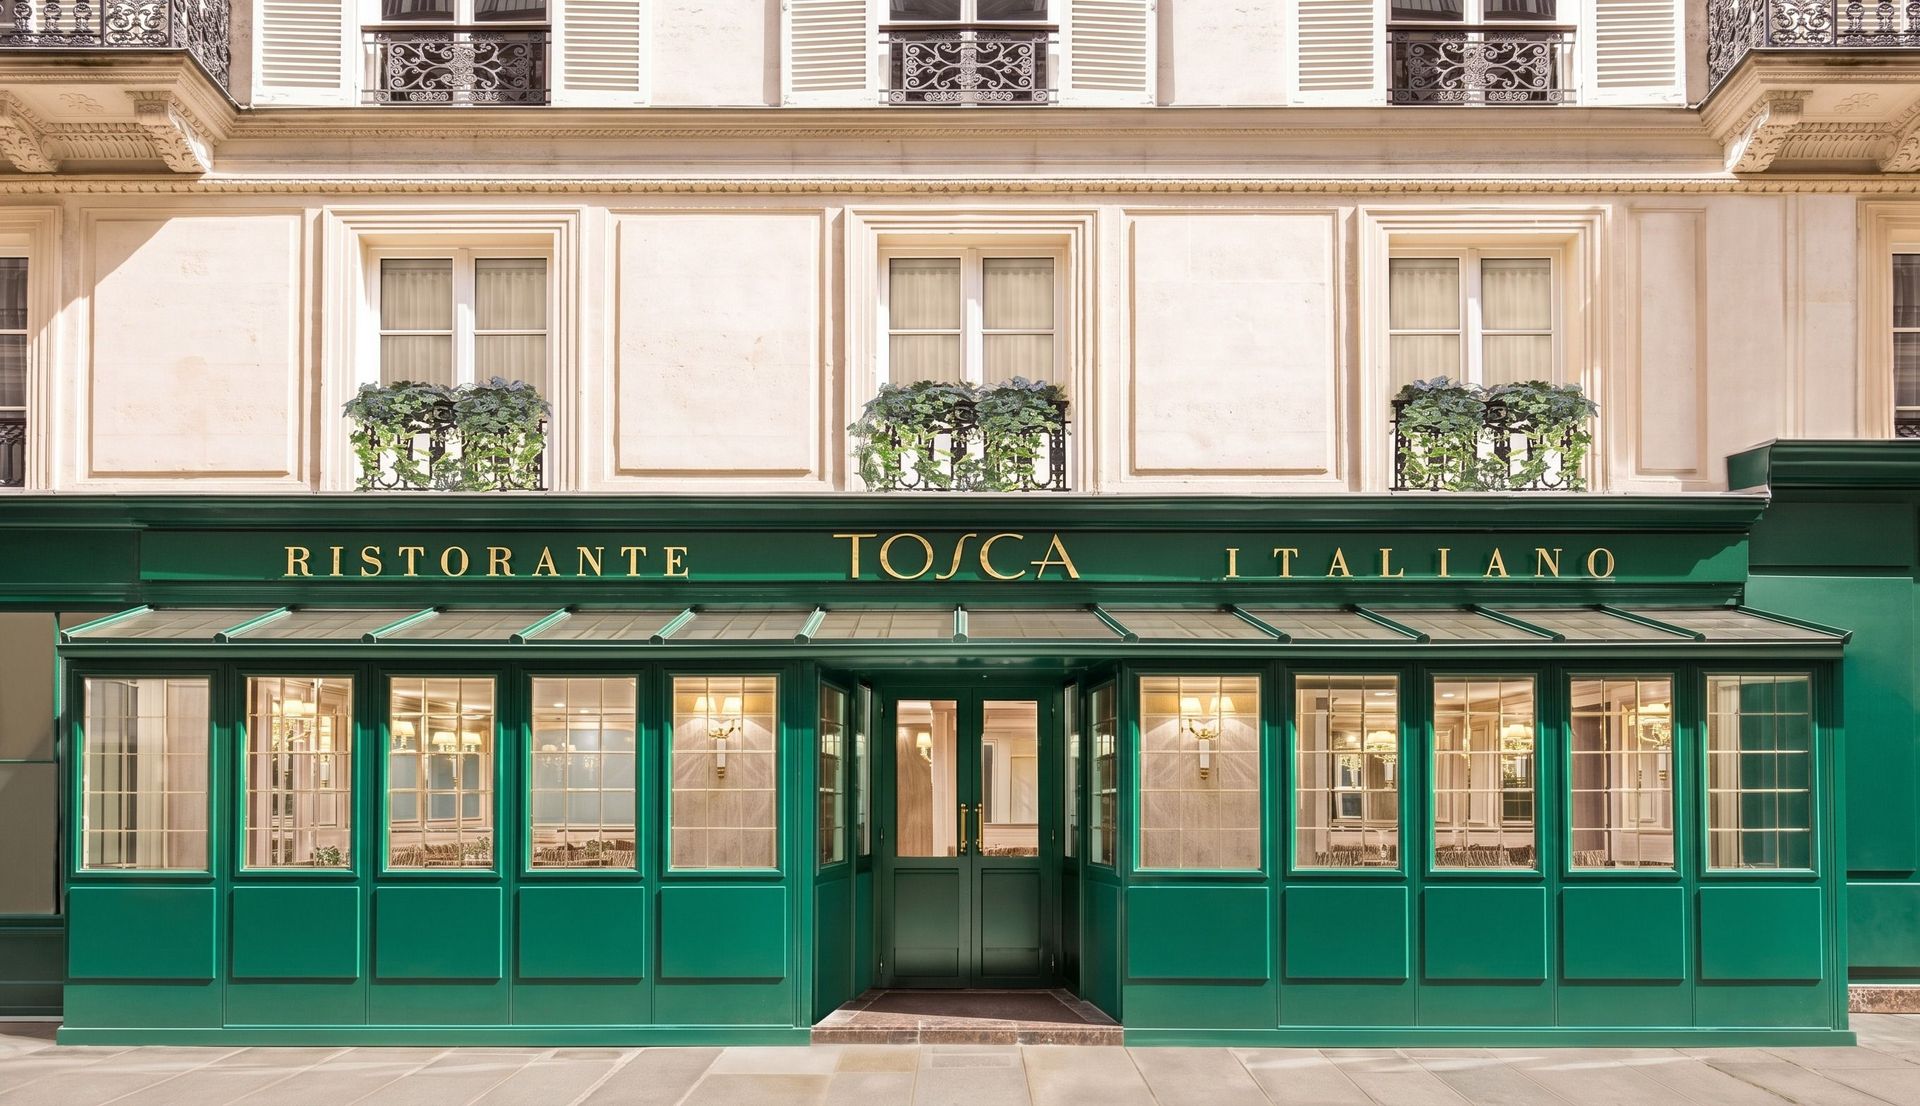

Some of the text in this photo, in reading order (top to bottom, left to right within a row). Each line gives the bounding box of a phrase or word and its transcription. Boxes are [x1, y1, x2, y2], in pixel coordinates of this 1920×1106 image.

[284, 533, 1615, 579] RISTORANTE TOSCA ITALIANO
